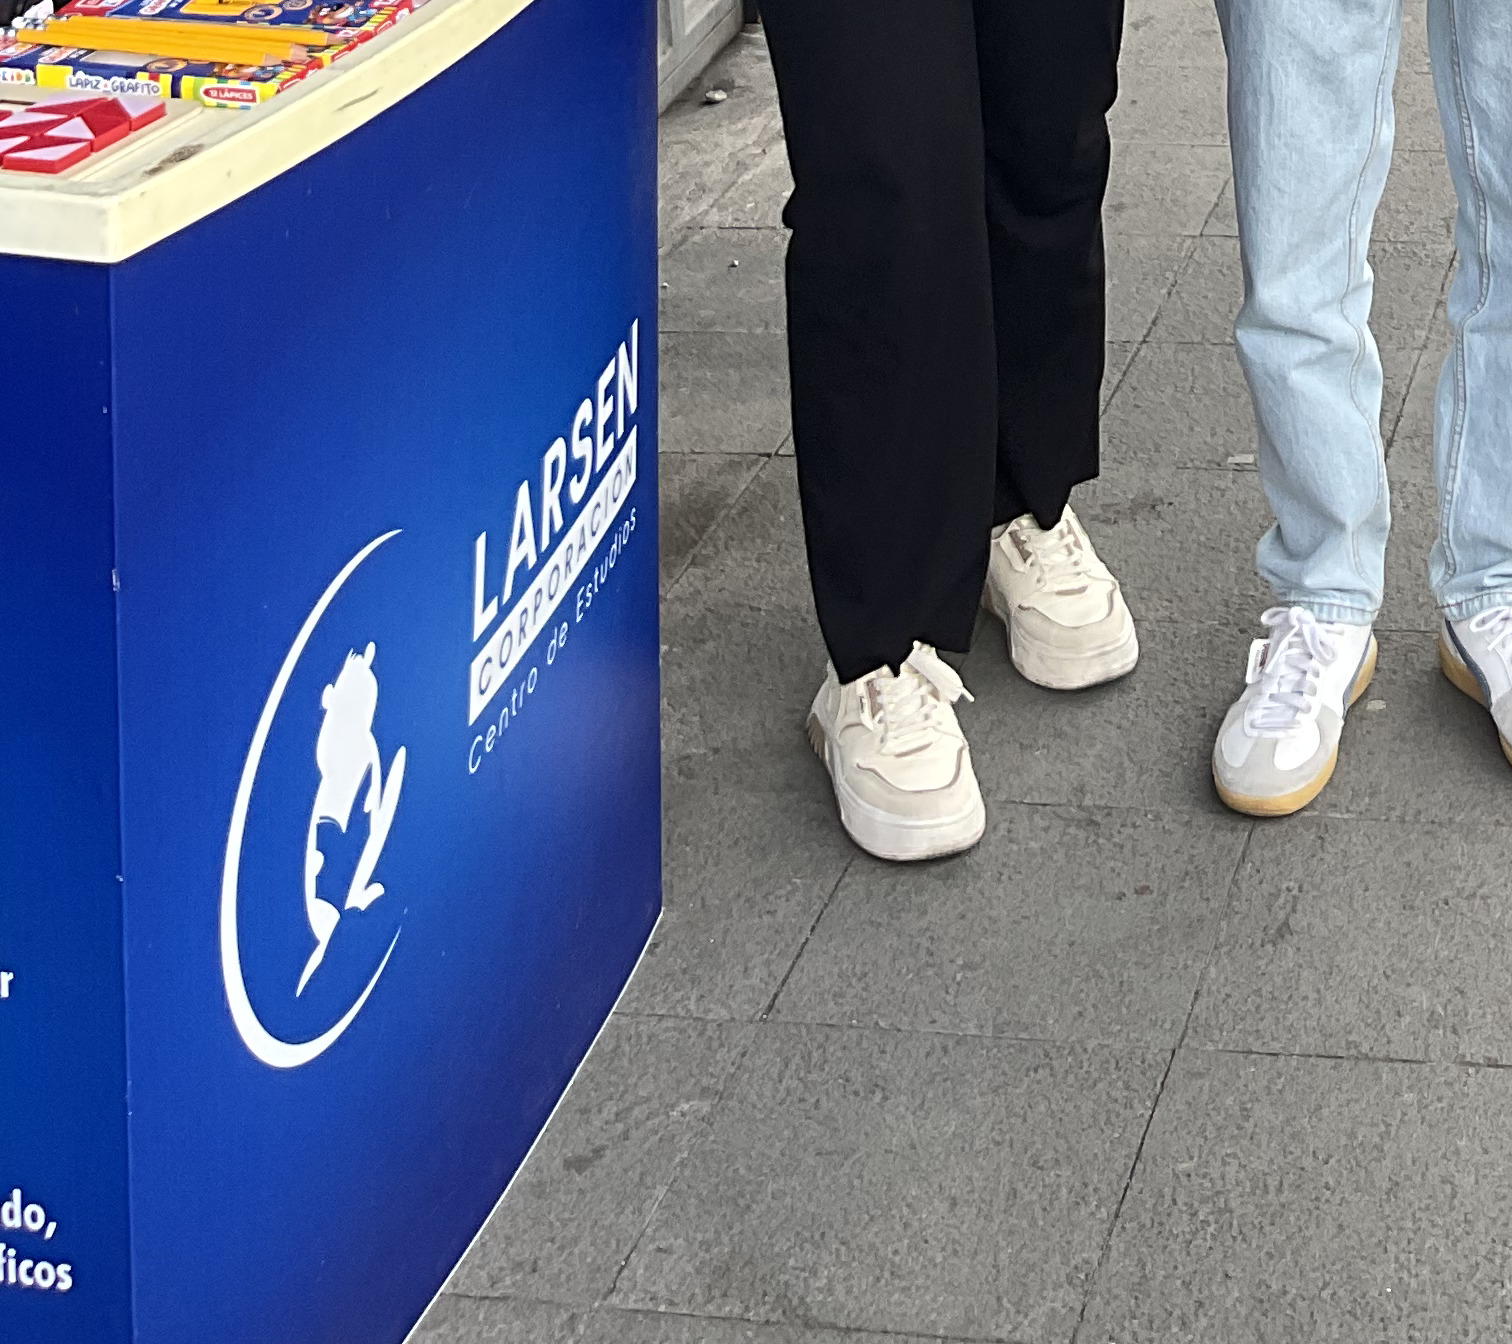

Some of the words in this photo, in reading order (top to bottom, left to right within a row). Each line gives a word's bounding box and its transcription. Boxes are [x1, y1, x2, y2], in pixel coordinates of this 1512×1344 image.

[111, 82, 160, 95] GRAFITO
[472, 318, 640, 643] LARSEN
[468, 667, 538, 776] Centro
[546, 620, 570, 666] de
[575, 506, 637, 624] Estudios
